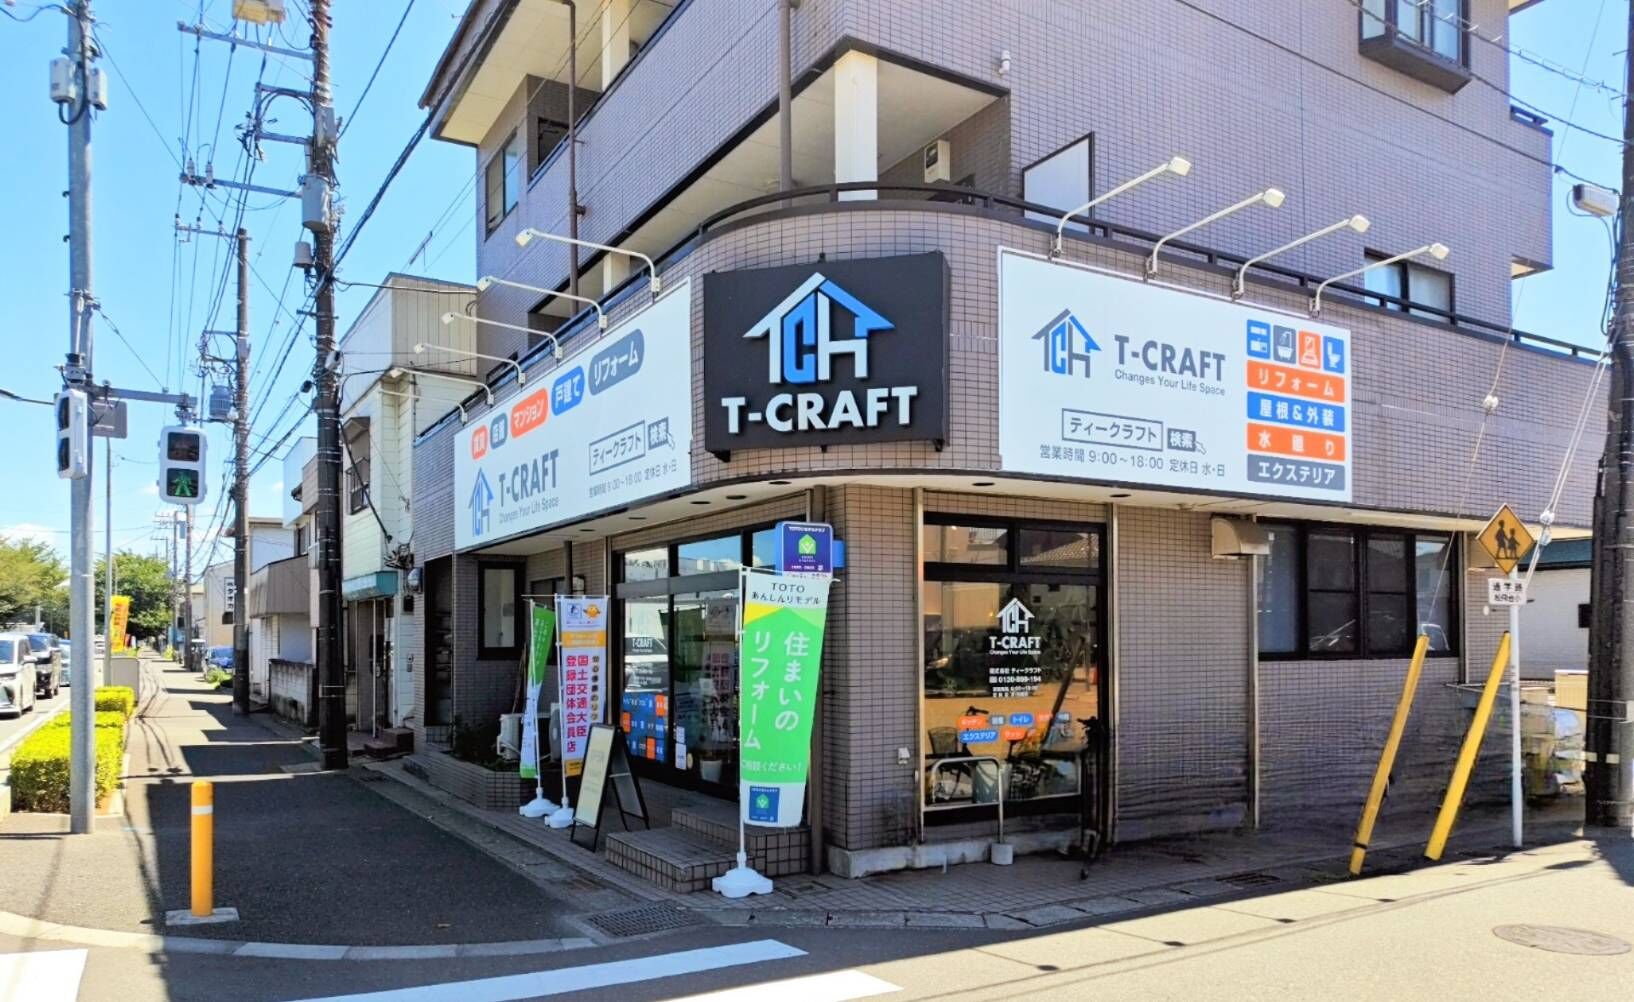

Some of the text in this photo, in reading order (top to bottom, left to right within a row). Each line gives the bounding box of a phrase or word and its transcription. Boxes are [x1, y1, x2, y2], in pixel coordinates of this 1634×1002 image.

[594, 340, 639, 387] リフォーム
[1114, 334, 1226, 382] T-CRAFT
[556, 374, 581, 409] 戸建て
[1114, 368, 1226, 396] Changes Your Life Space
[1259, 367, 1335, 397] リフォーム
[512, 399, 545, 430] マンション
[721, 386, 918, 434] T-CRAFT
[1070, 416, 1158, 443] ティークラフト
[1169, 430, 1194, 449] 検索
[592, 431, 641, 467] ティークラフト
[1040, 444, 1085, 463] 営業時間
[1169, 458, 1198, 474] 定休日
[1201, 463, 1225, 477] 水・日
[498, 448, 560, 508] T-CRAFT
[1258, 461, 1336, 485] エクステリア
[751, 591, 820, 605] あんしんリモデル
[771, 582, 806, 594] TOTO
[989, 636, 1042, 649] T-CRAFT
[576, 654, 589, 738] 国土交通大臣
[744, 631, 771, 751] リフォーム
[774, 631, 810, 731] 住まいの
[1012, 715, 1032, 725] トイレ
[962, 731, 997, 741] エクステリア
